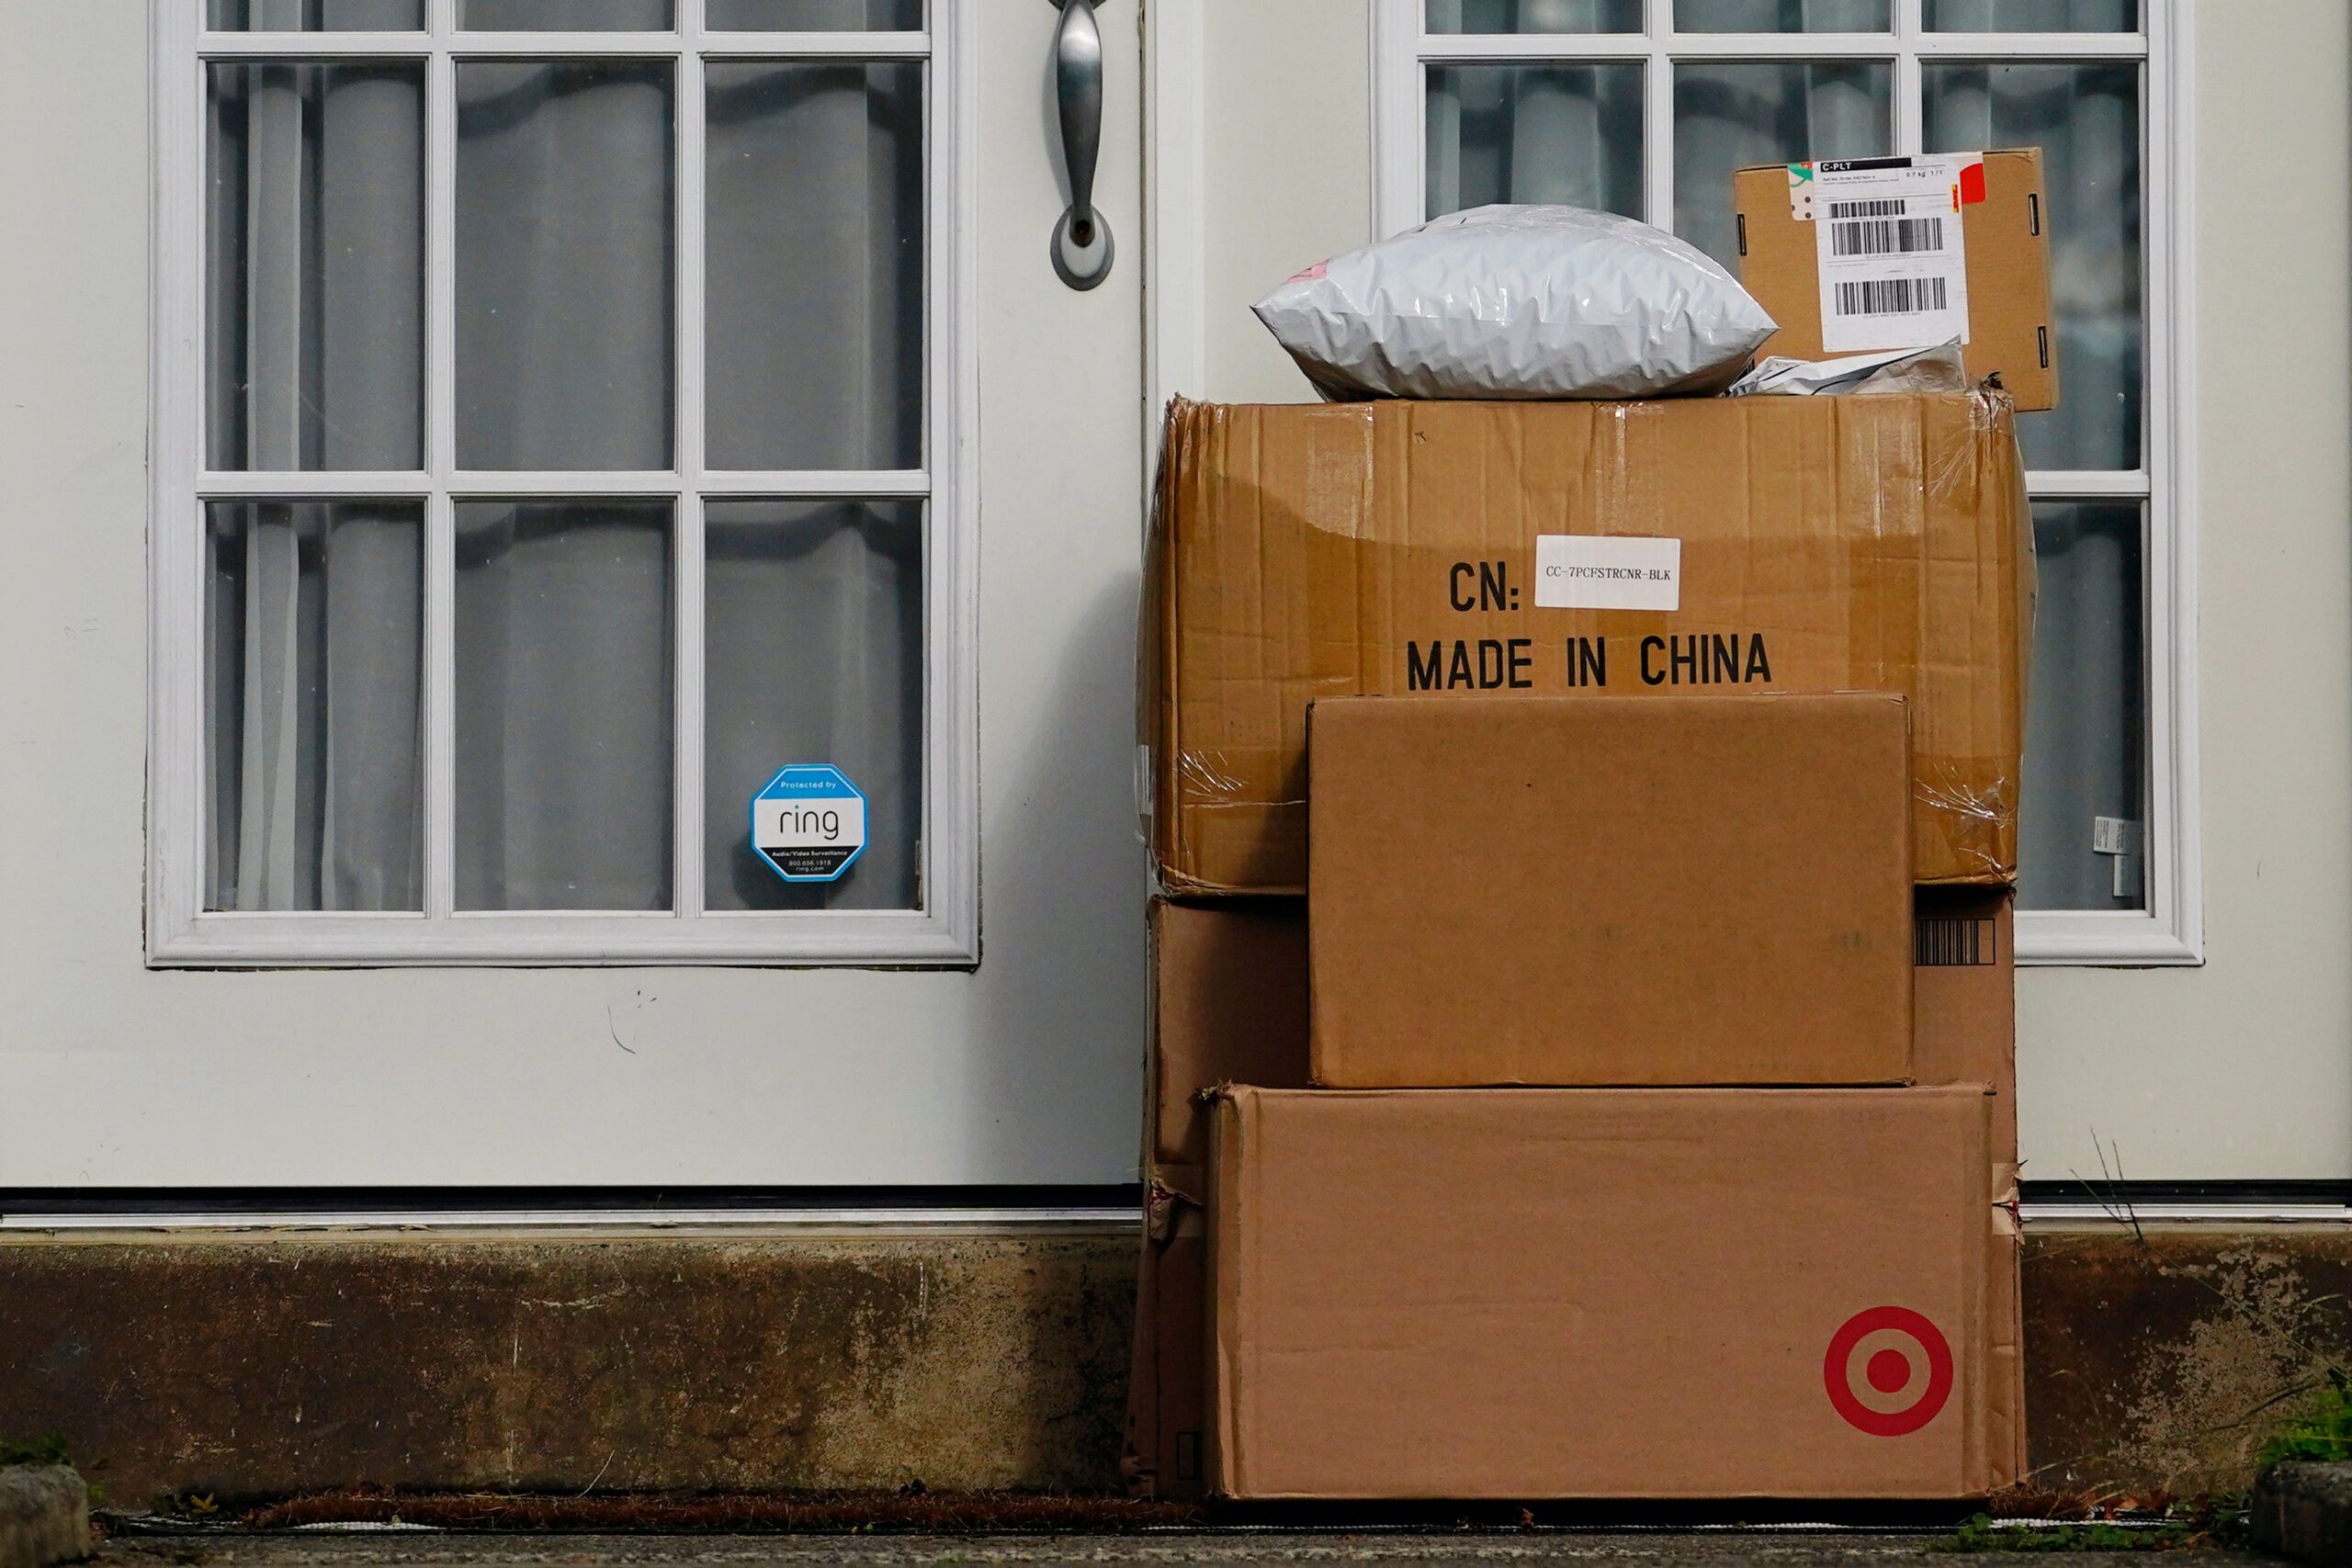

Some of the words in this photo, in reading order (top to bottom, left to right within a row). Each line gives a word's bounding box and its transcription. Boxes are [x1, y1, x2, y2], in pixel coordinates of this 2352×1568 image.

[1822, 162, 1852, 172] C-PLT
[1451, 561, 1519, 611] CN:
[1546, 566, 1671, 581] CC-7PCFSTRCNR-BLK
[1408, 639, 1532, 691] MADE
[1567, 637, 1605, 687] IN
[1641, 634, 1771, 686] CHINA
[780, 781, 823, 789] Protected
[825, 781, 837, 790] by
[779, 805, 839, 840] ring
